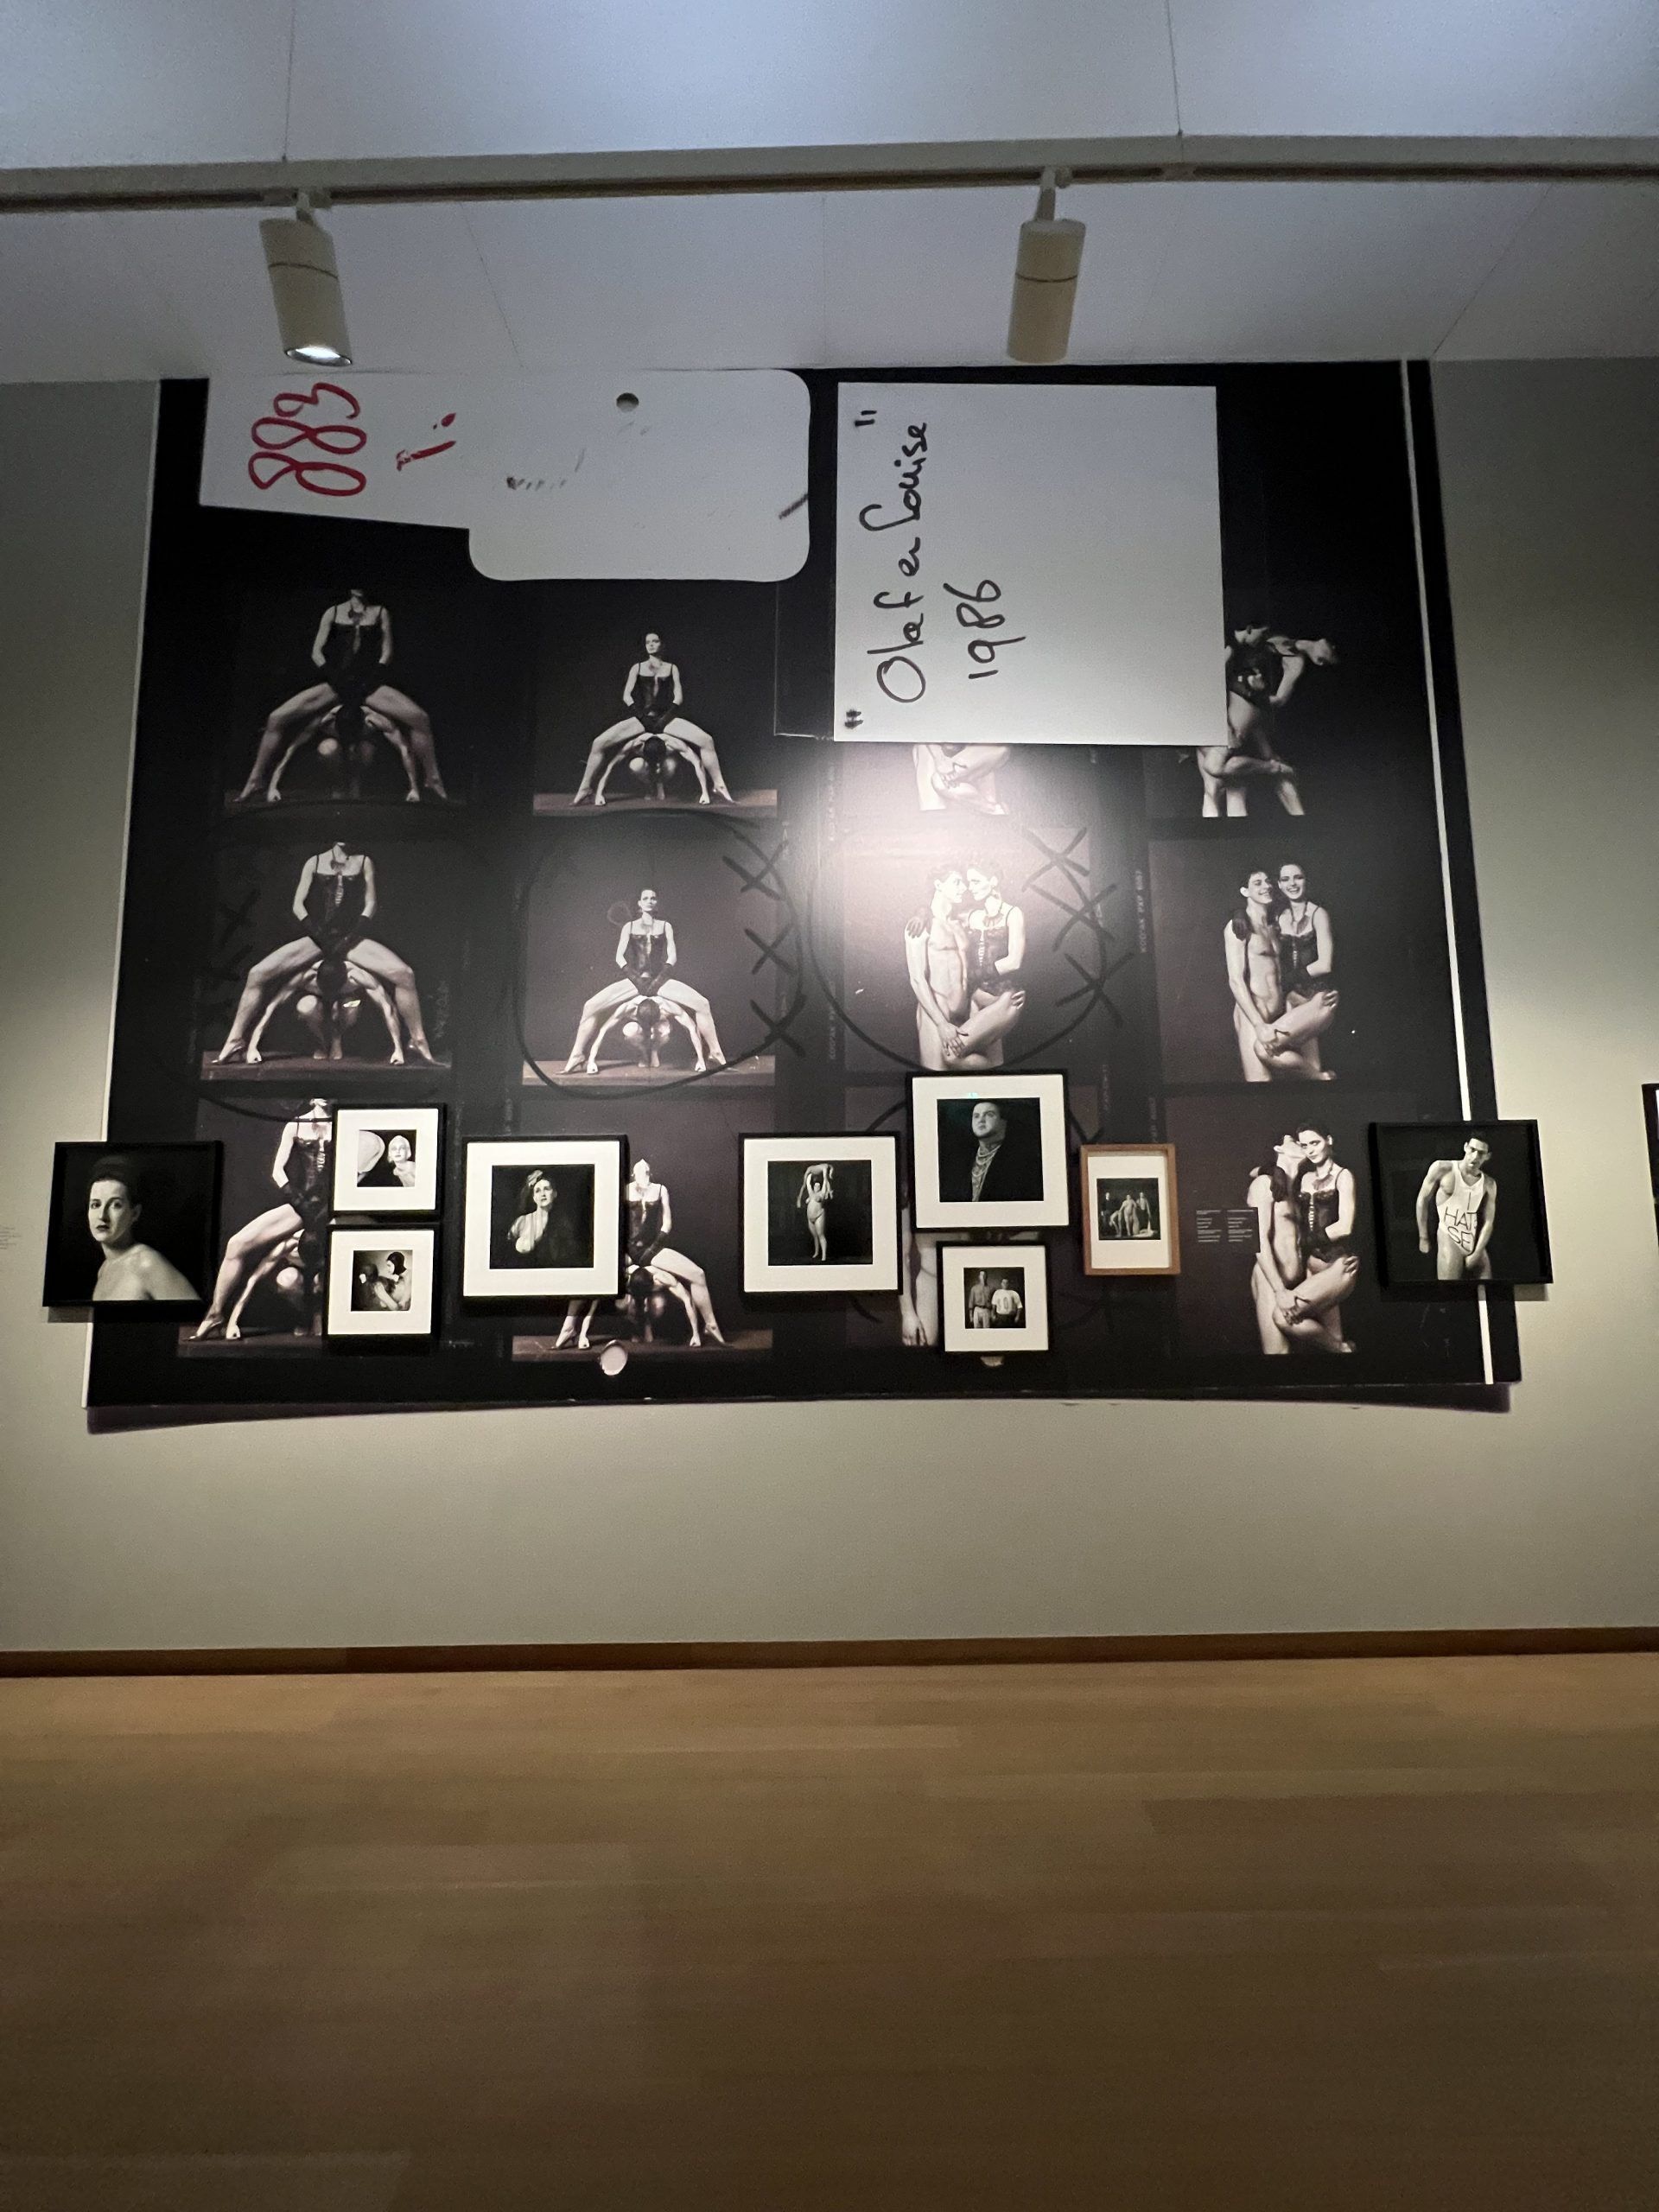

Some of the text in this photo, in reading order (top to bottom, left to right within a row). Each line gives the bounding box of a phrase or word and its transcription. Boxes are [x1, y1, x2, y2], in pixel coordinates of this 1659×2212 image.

[943, 579, 1026, 679] 1986
[1466, 1192, 1471, 1210] I
[1447, 1226, 1475, 1253] SE
